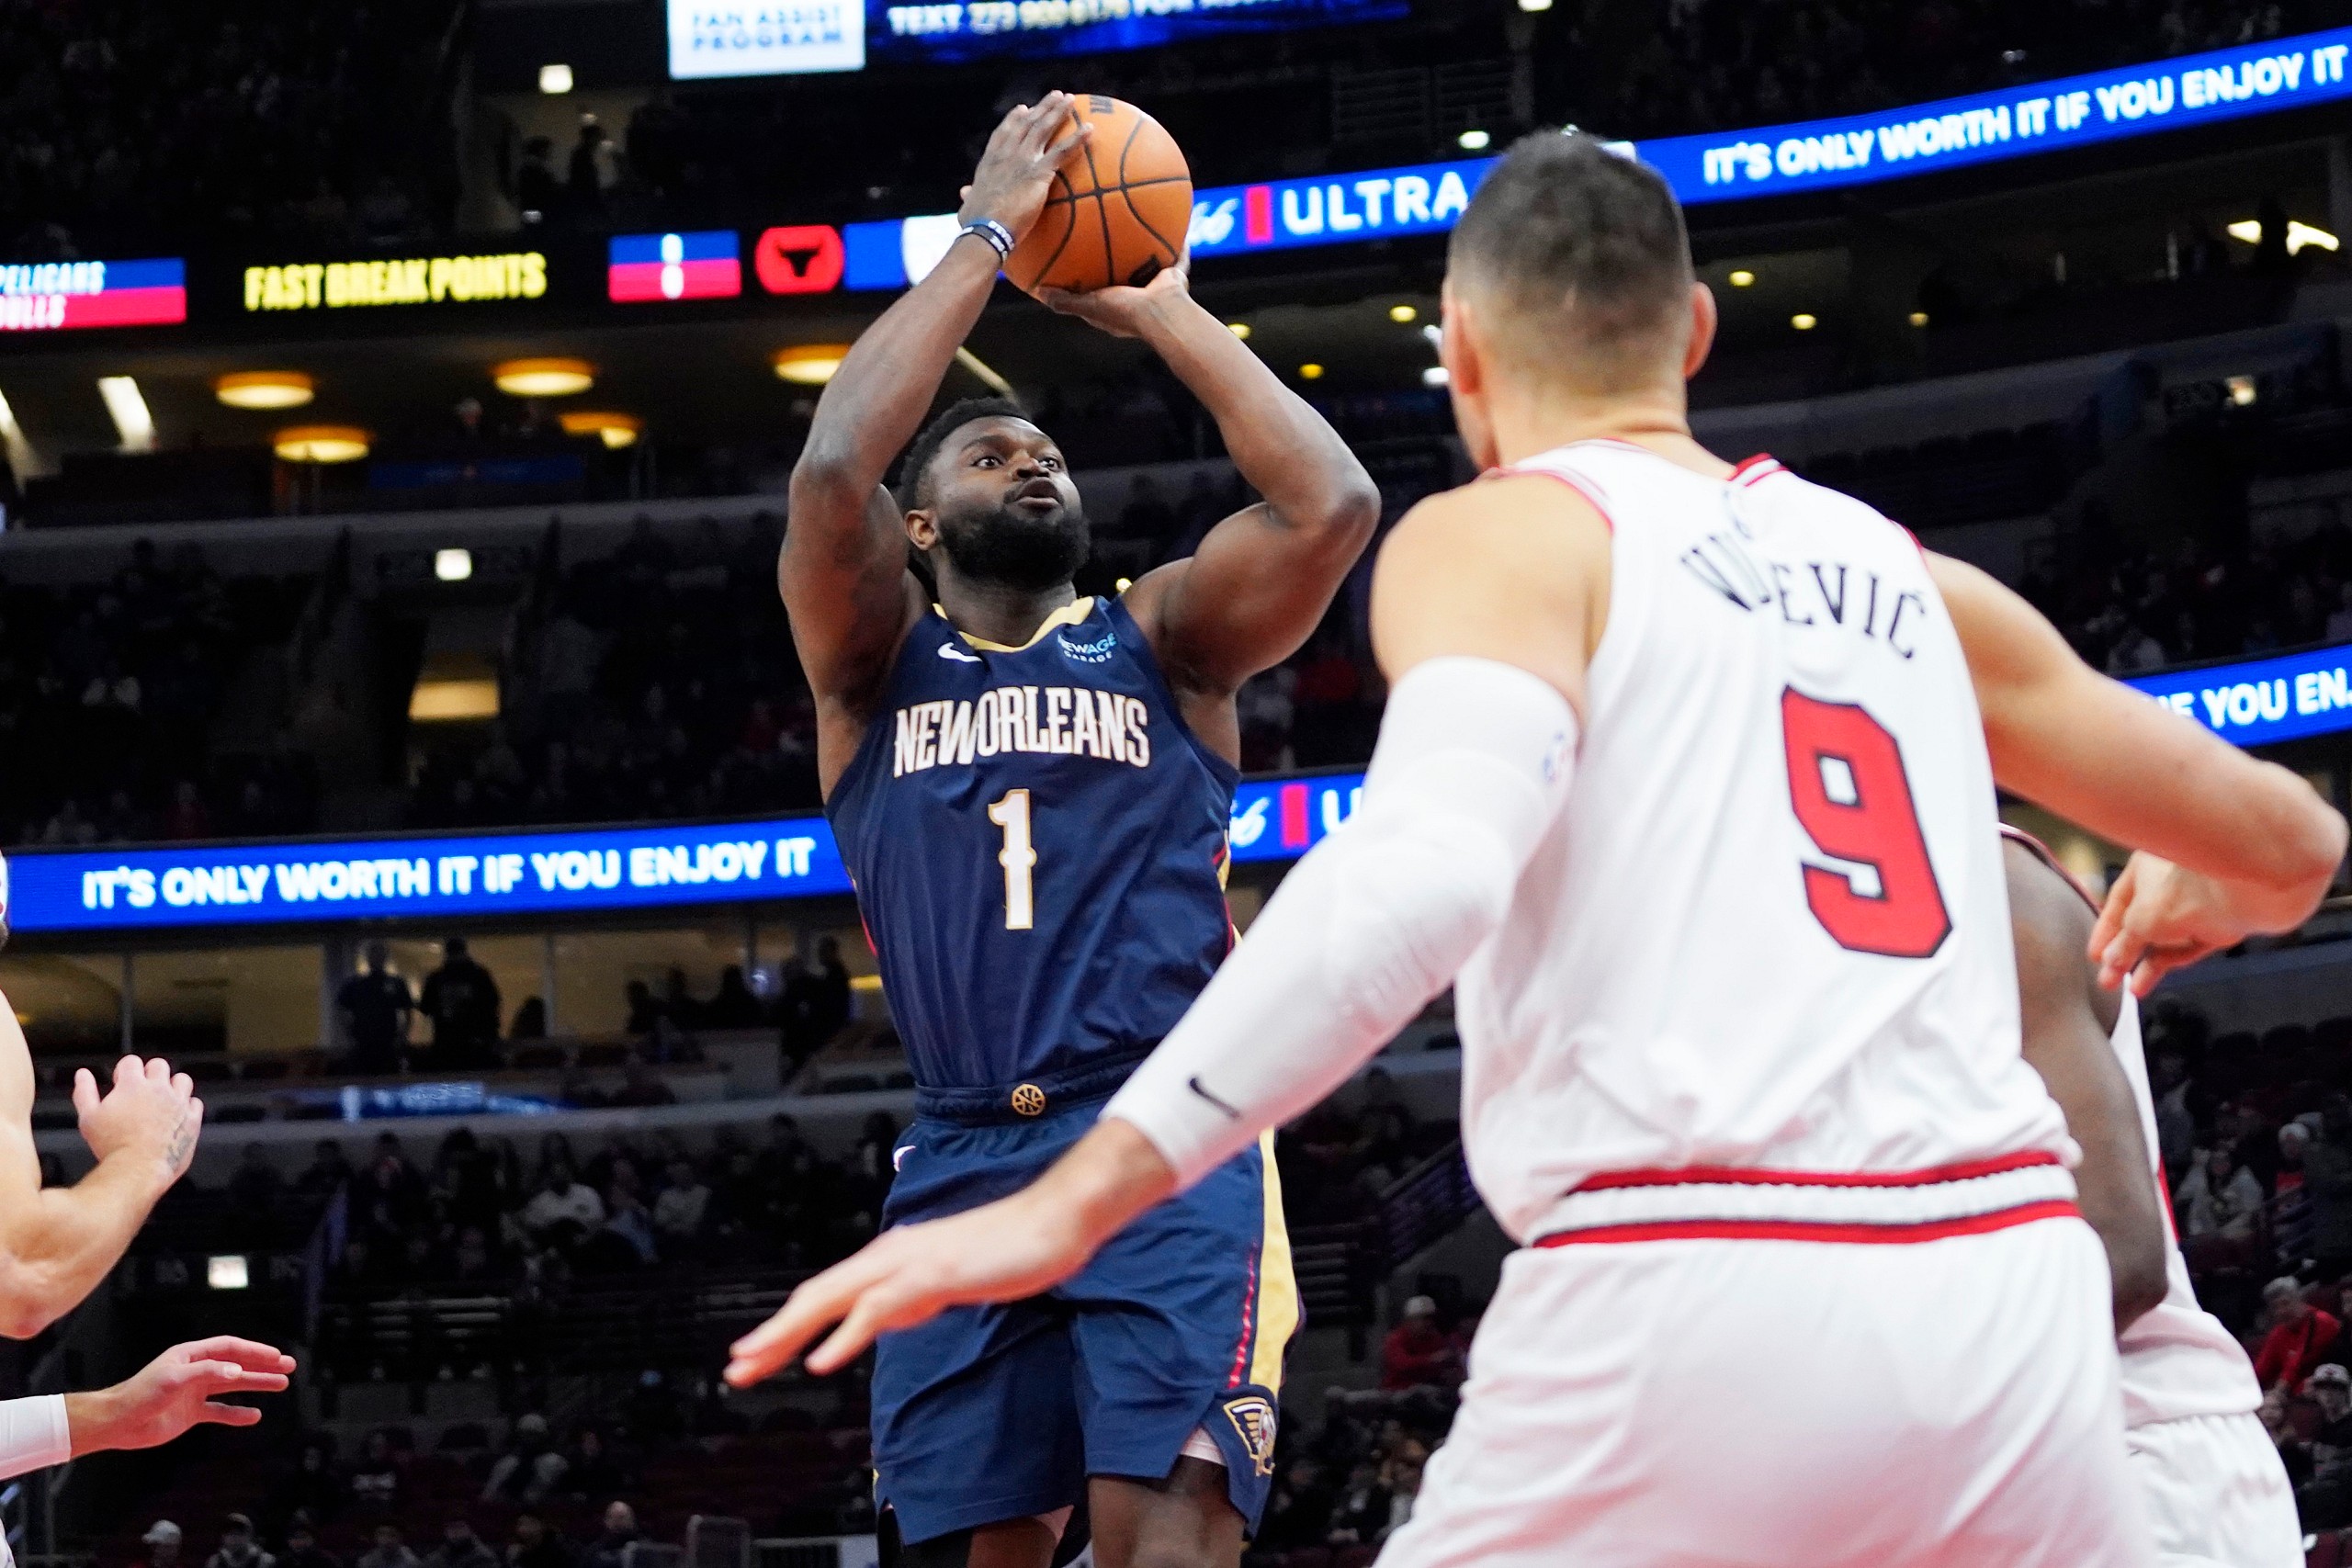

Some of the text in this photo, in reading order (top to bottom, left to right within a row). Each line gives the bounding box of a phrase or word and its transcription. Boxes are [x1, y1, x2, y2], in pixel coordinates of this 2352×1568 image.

[691, 29, 844, 51] PROGRAM
[887, 5, 963, 35] TEXT
[1702, 43, 2349, 185] IT'S ONLY WORTH IT IF YOU ENJOY IT
[1282, 171, 1470, 237] ULTRA
[244, 252, 547, 310] FAST BREAK POINTS
[2199, 678, 2289, 729] YOU
[1781, 683, 1953, 958] 9
[83, 836, 817, 908] IT'S ONLY WORTH IT IF YOU ENJOY IT
[987, 788, 1037, 931] 1
